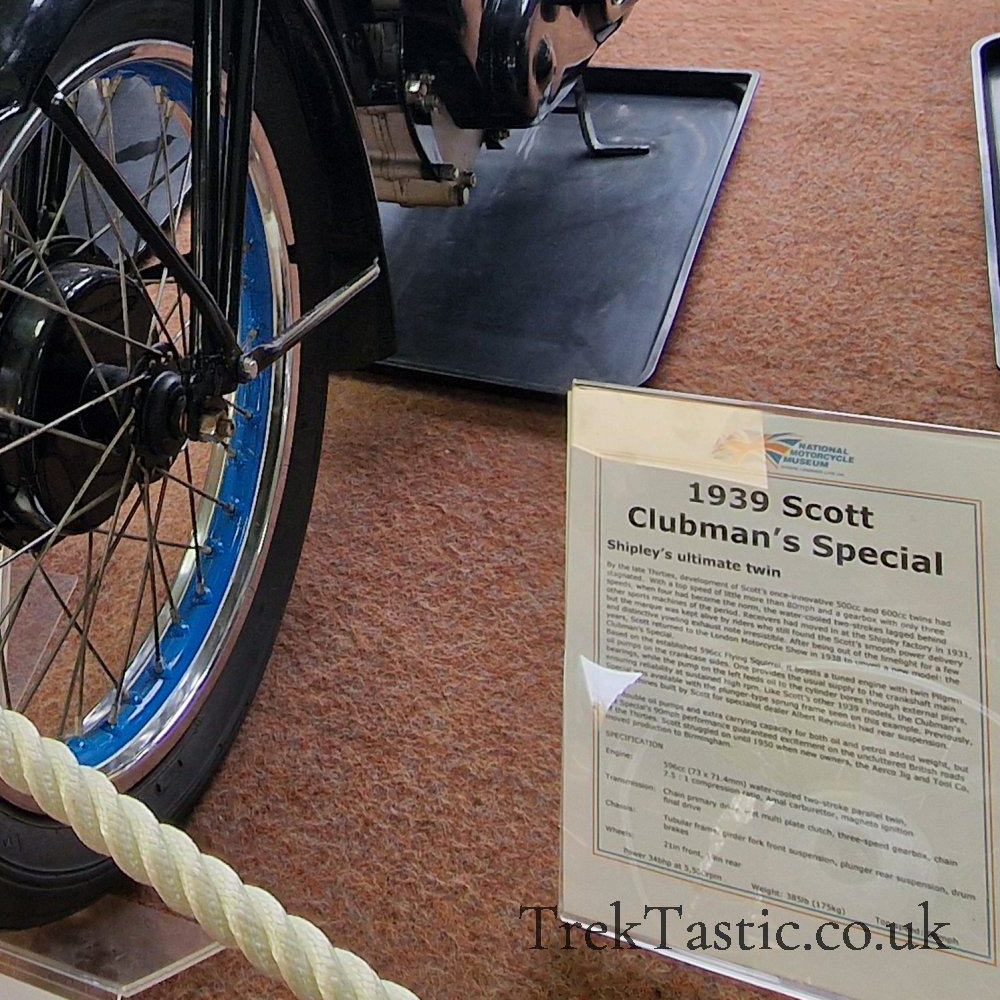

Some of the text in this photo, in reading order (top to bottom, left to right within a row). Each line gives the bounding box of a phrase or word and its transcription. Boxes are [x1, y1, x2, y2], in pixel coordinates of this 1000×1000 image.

[783, 456, 829, 468] MUSEUM
[790, 449, 855, 464] MOTORCYCLE
[798, 443, 849, 455] NATIONAL
[689, 482, 874, 529] 1939 Scott
[628, 506, 943, 576] Clubman's Special
[607, 539, 781, 578] Shipley's ultimate twin
